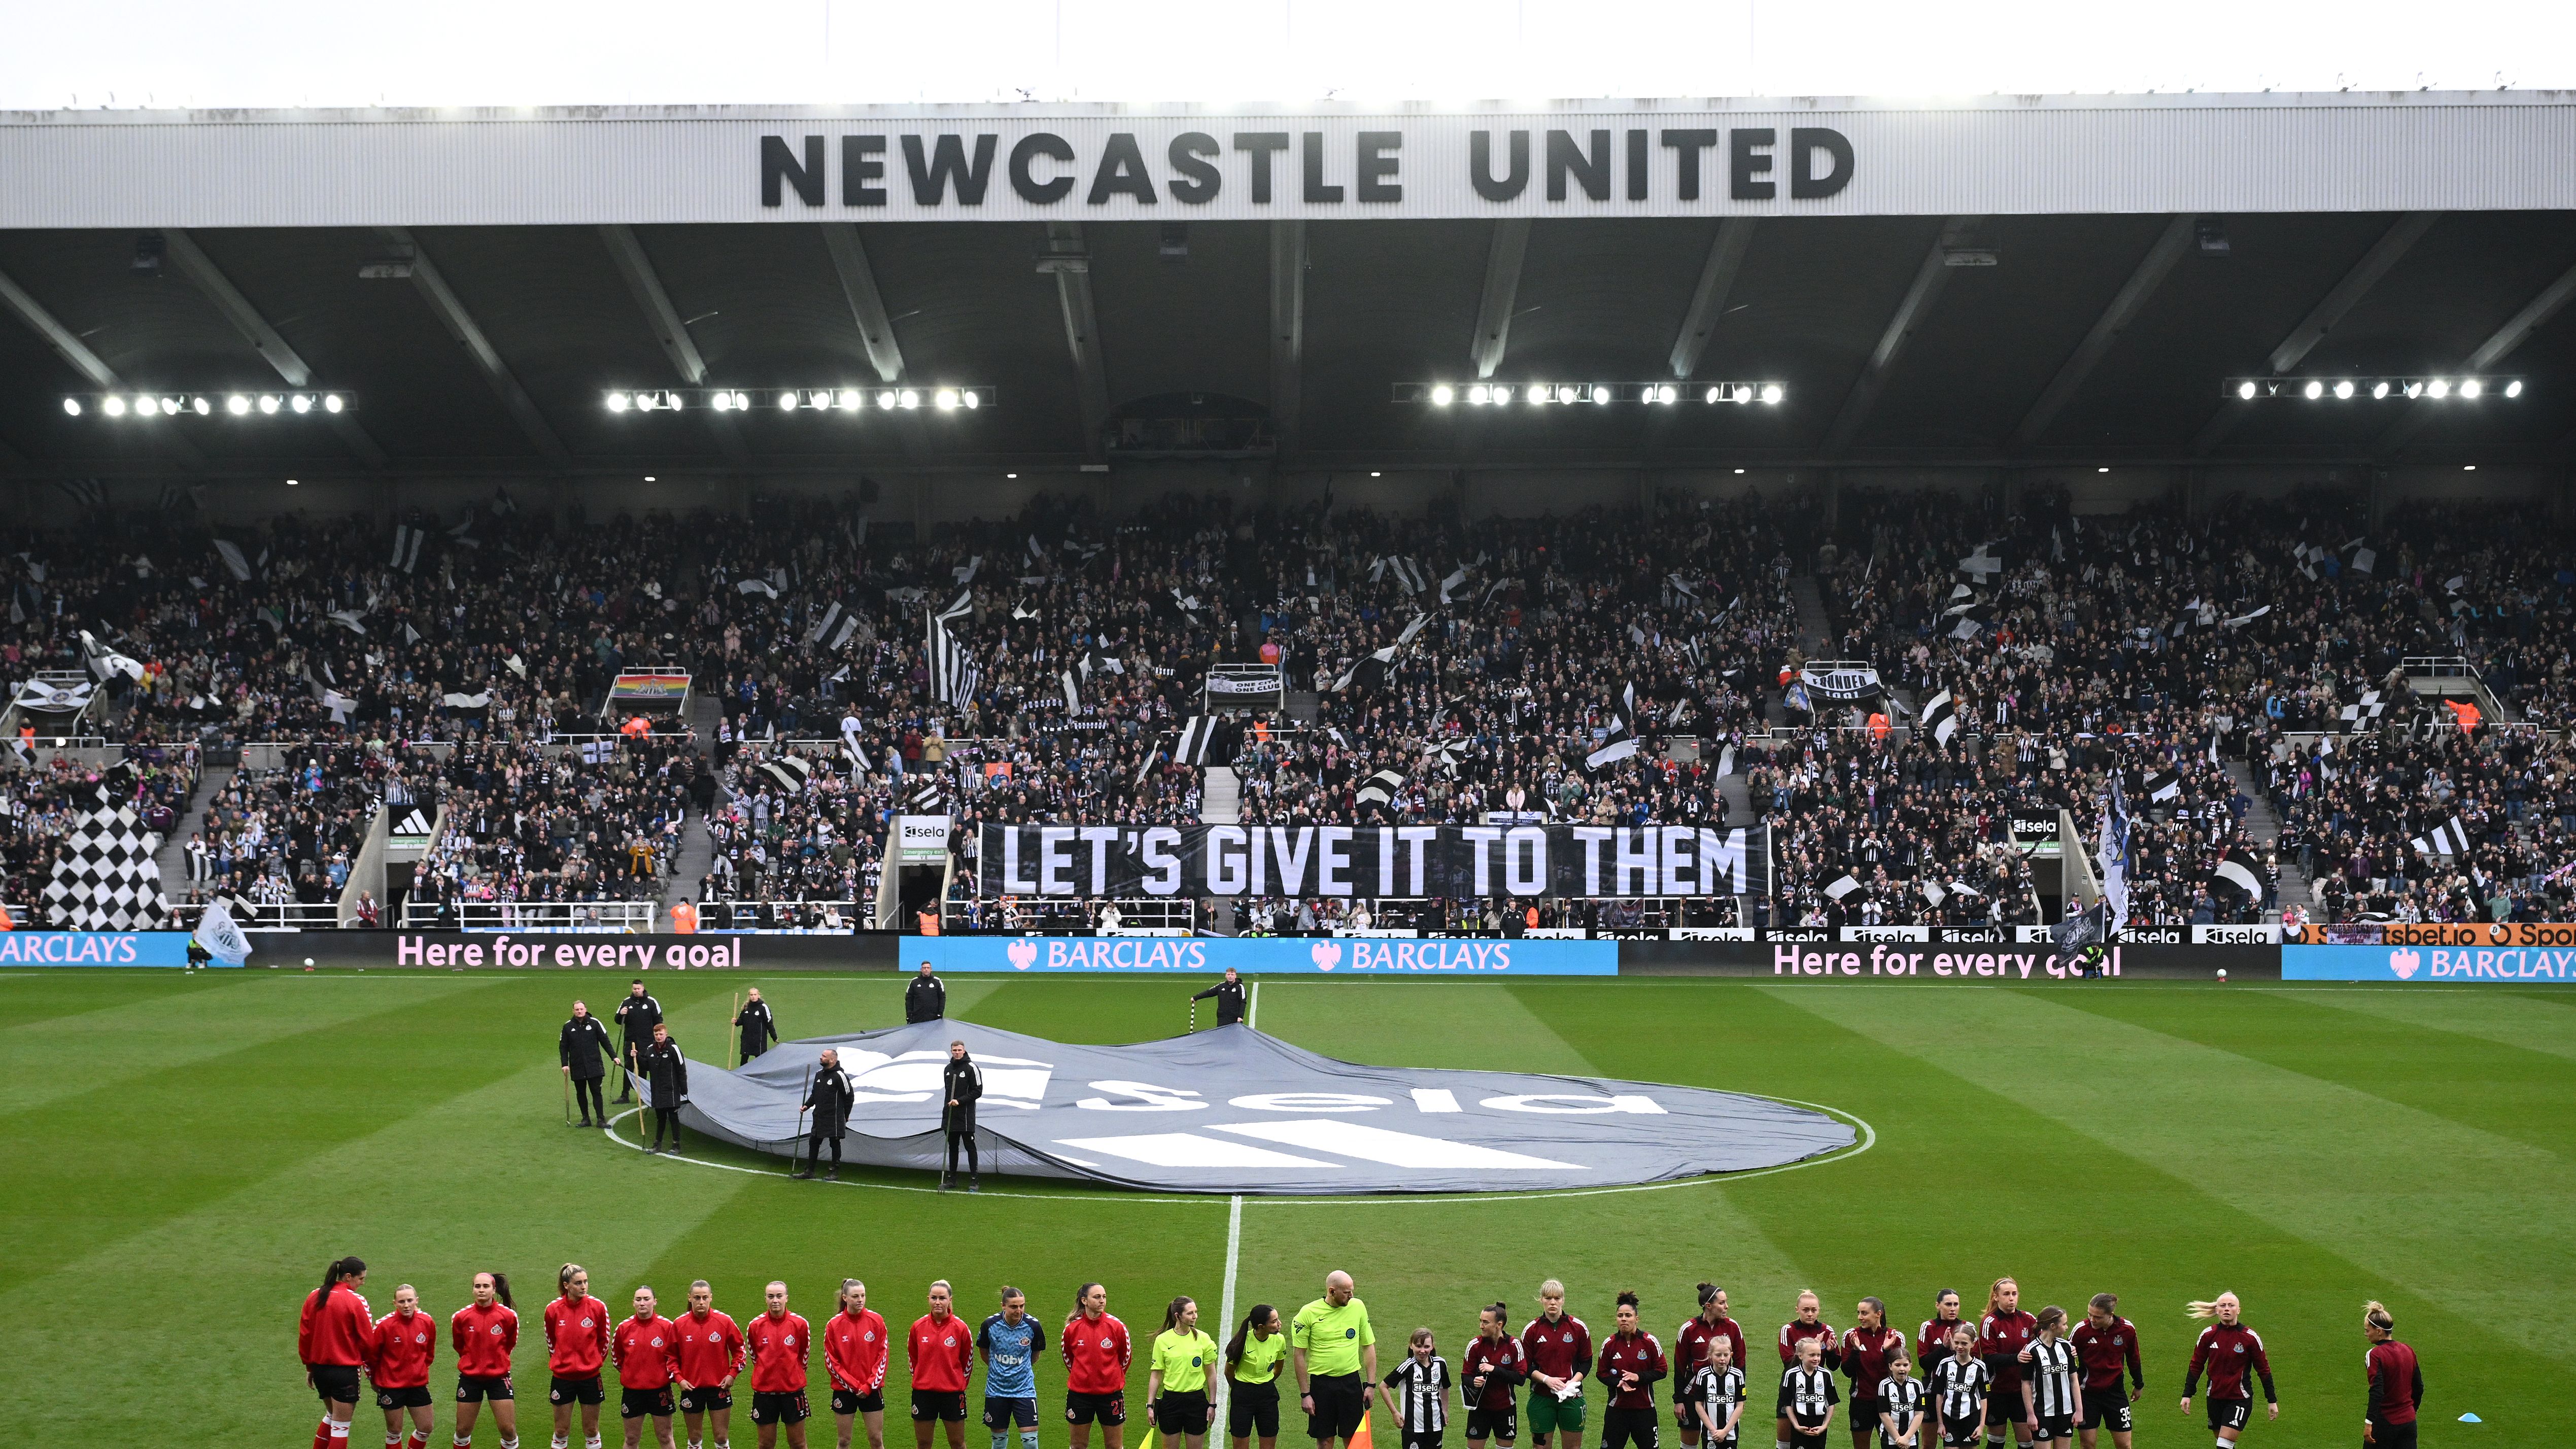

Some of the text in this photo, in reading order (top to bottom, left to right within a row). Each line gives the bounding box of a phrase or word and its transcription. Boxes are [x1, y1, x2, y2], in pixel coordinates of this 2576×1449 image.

[761, 126, 1856, 208] NEWCASTLE UNITED
[1257, 683, 1280, 691] CLUB
[917, 826, 944, 837] sela
[2027, 820, 2056, 832] sela
[1004, 826, 1746, 895] LET'S GIVE IT TO THEM
[2138, 928, 2179, 943] sela
[2226, 928, 2267, 944] sela
[398, 936, 740, 970] Here for every goal
[1048, 941, 1206, 968] BARCLAYS
[1352, 943, 1510, 970] BARCLAYS
[1775, 945, 1860, 975] Here
[1870, 945, 1924, 975] for
[1934, 953, 2035, 979] every
[1076, 1080, 1668, 1114] sela
[2051, 1364, 2069, 1372] sela
[1422, 1384, 1439, 1392] sela
[1716, 1394, 1734, 1402] sela
[1806, 1394, 1825, 1402] sela
[1031, 1399, 1037, 1413] 1
[1111, 1398, 1123, 1415] 27
[2235, 1405, 2245, 1421] 11
[2120, 1406, 2131, 1422] 35
[1508, 1415, 1515, 1429] 4
[1653, 1426, 1658, 1440] 3
